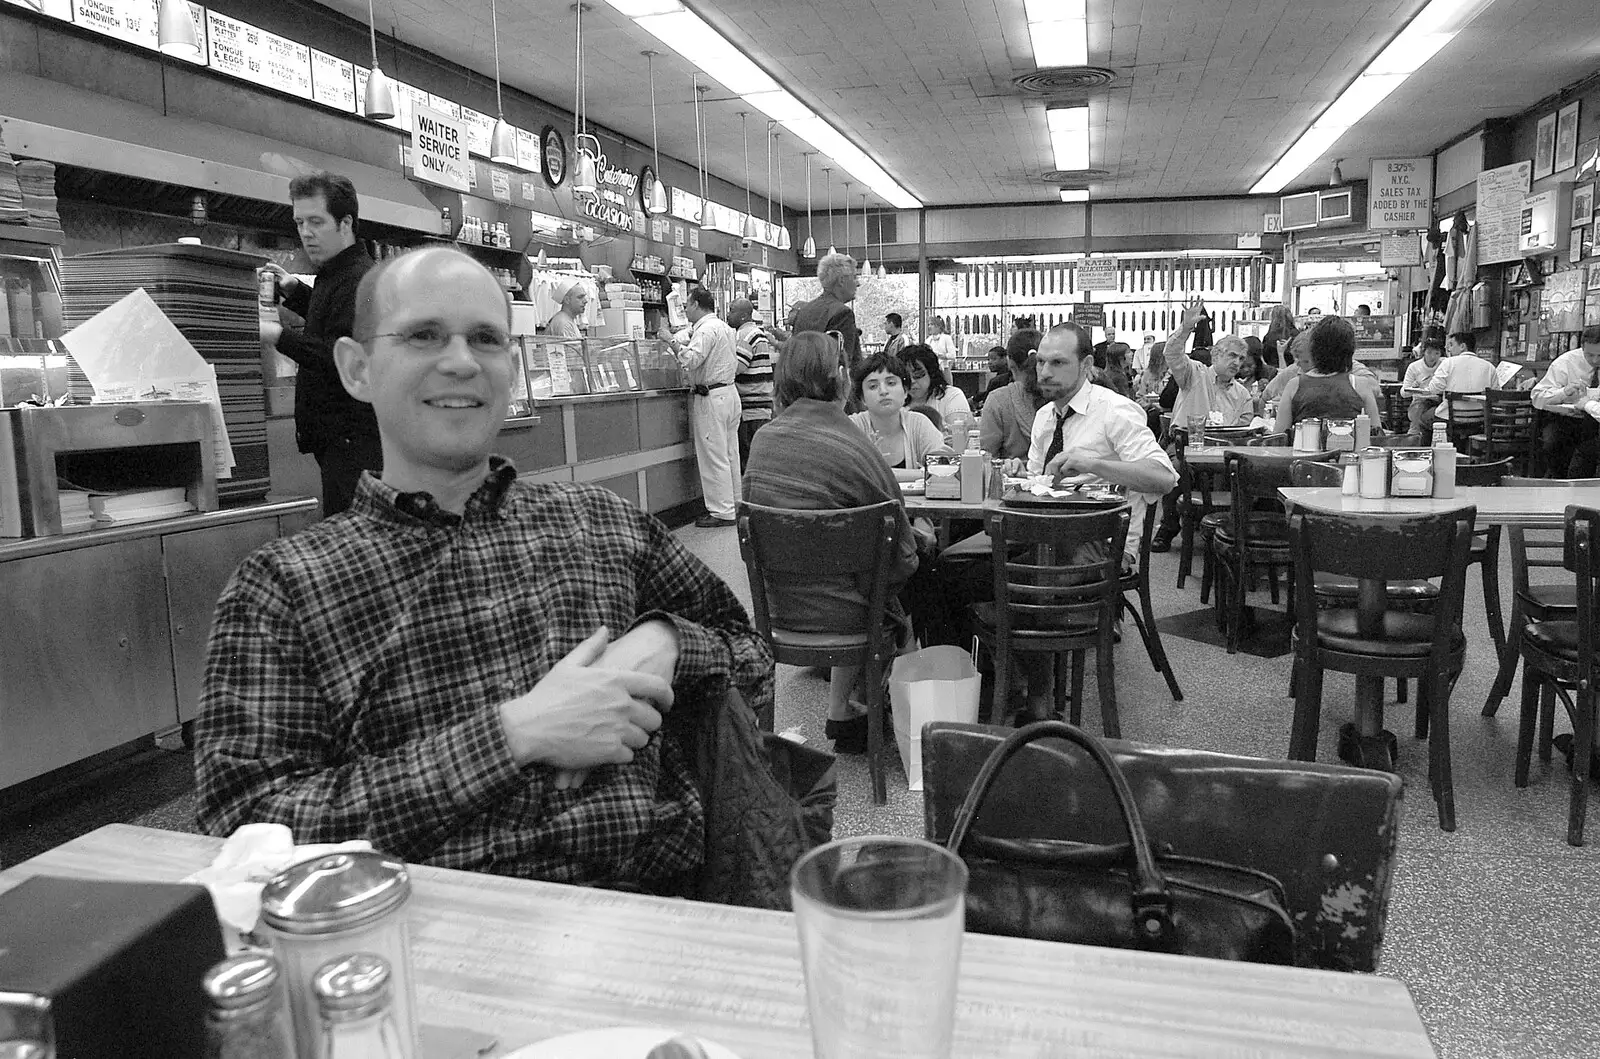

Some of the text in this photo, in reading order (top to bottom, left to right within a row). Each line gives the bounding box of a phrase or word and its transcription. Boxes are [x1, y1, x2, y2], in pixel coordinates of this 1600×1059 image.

[79, 6, 121, 28] SANDWICH
[209, 16, 241, 33] THREE MEAT
[214, 26, 237, 38] PLATTER
[212, 41, 244, 58] TONGUE
[213, 50, 220, 58] &
[223, 53, 245, 66] EGGS
[417, 114, 459, 144] WAITER
[419, 134, 461, 160] SERVICE
[421, 154, 446, 173] ONLY
[1387, 163, 1416, 172] 8.375%
[596, 153, 639, 197] Catering
[1391, 175, 1411, 185] N.Y.C.
[1380, 187, 1421, 197] SALES TAX
[1373, 199, 1428, 210] ADDED BY THE
[585, 199, 633, 232] OCCASIONS
[1267, 216, 1281, 231] EX
[1384, 211, 1416, 222] CASHIER
